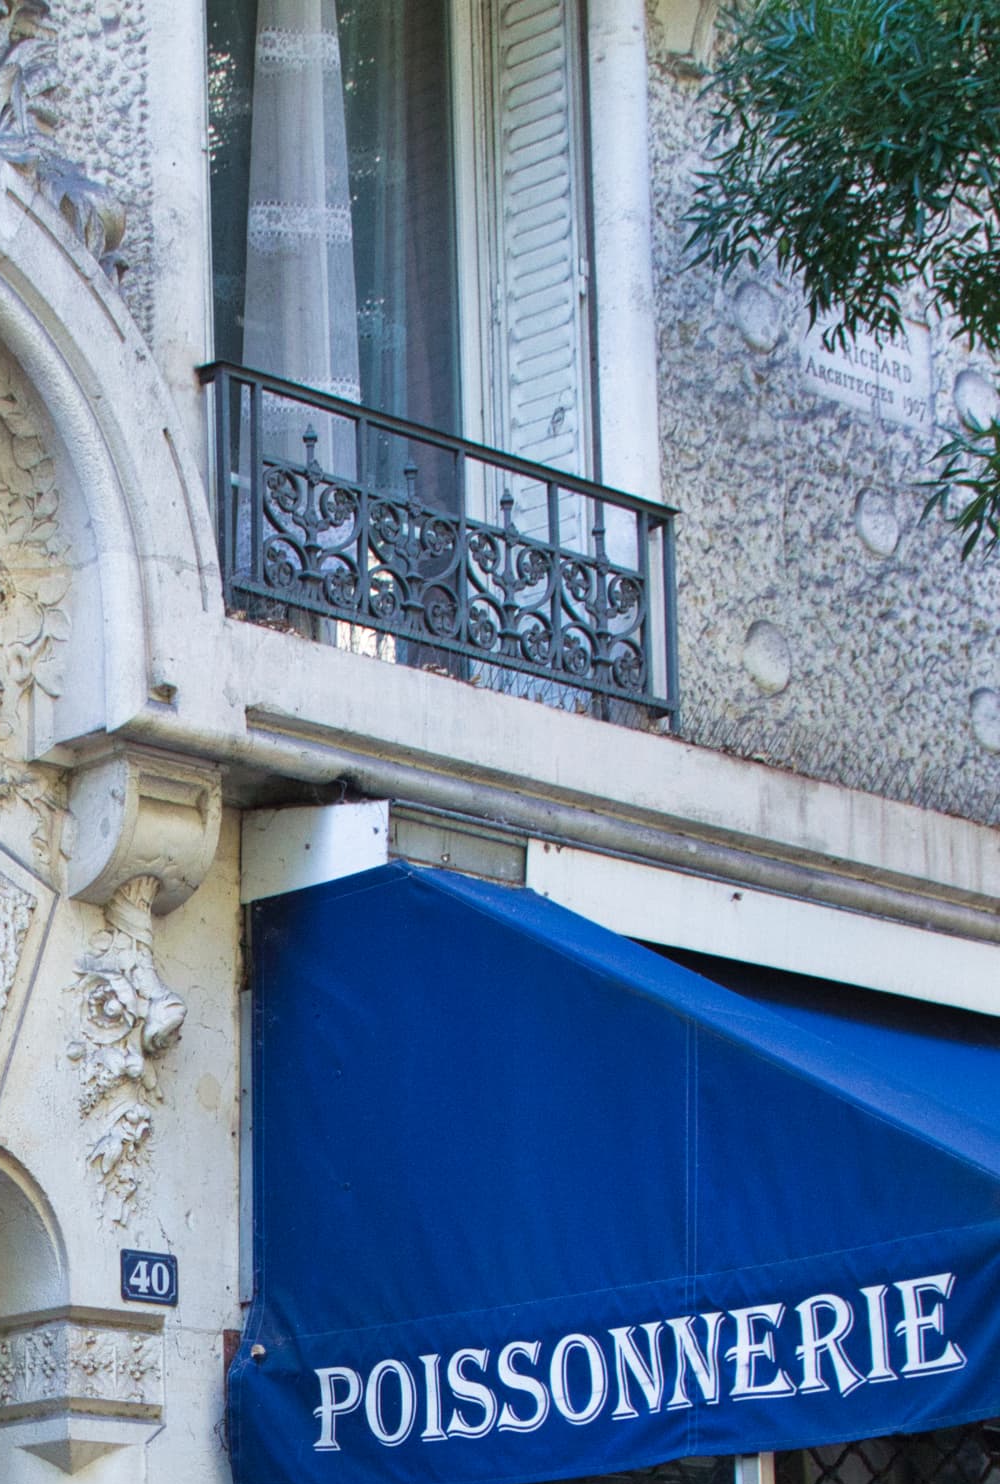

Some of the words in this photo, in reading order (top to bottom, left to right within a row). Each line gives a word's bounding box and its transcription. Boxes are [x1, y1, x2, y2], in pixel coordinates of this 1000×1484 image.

[805, 355, 894, 404] ARCHITECTES
[129, 1260, 170, 1296] 40
[312, 1272, 967, 1452] POISSONNERIE
